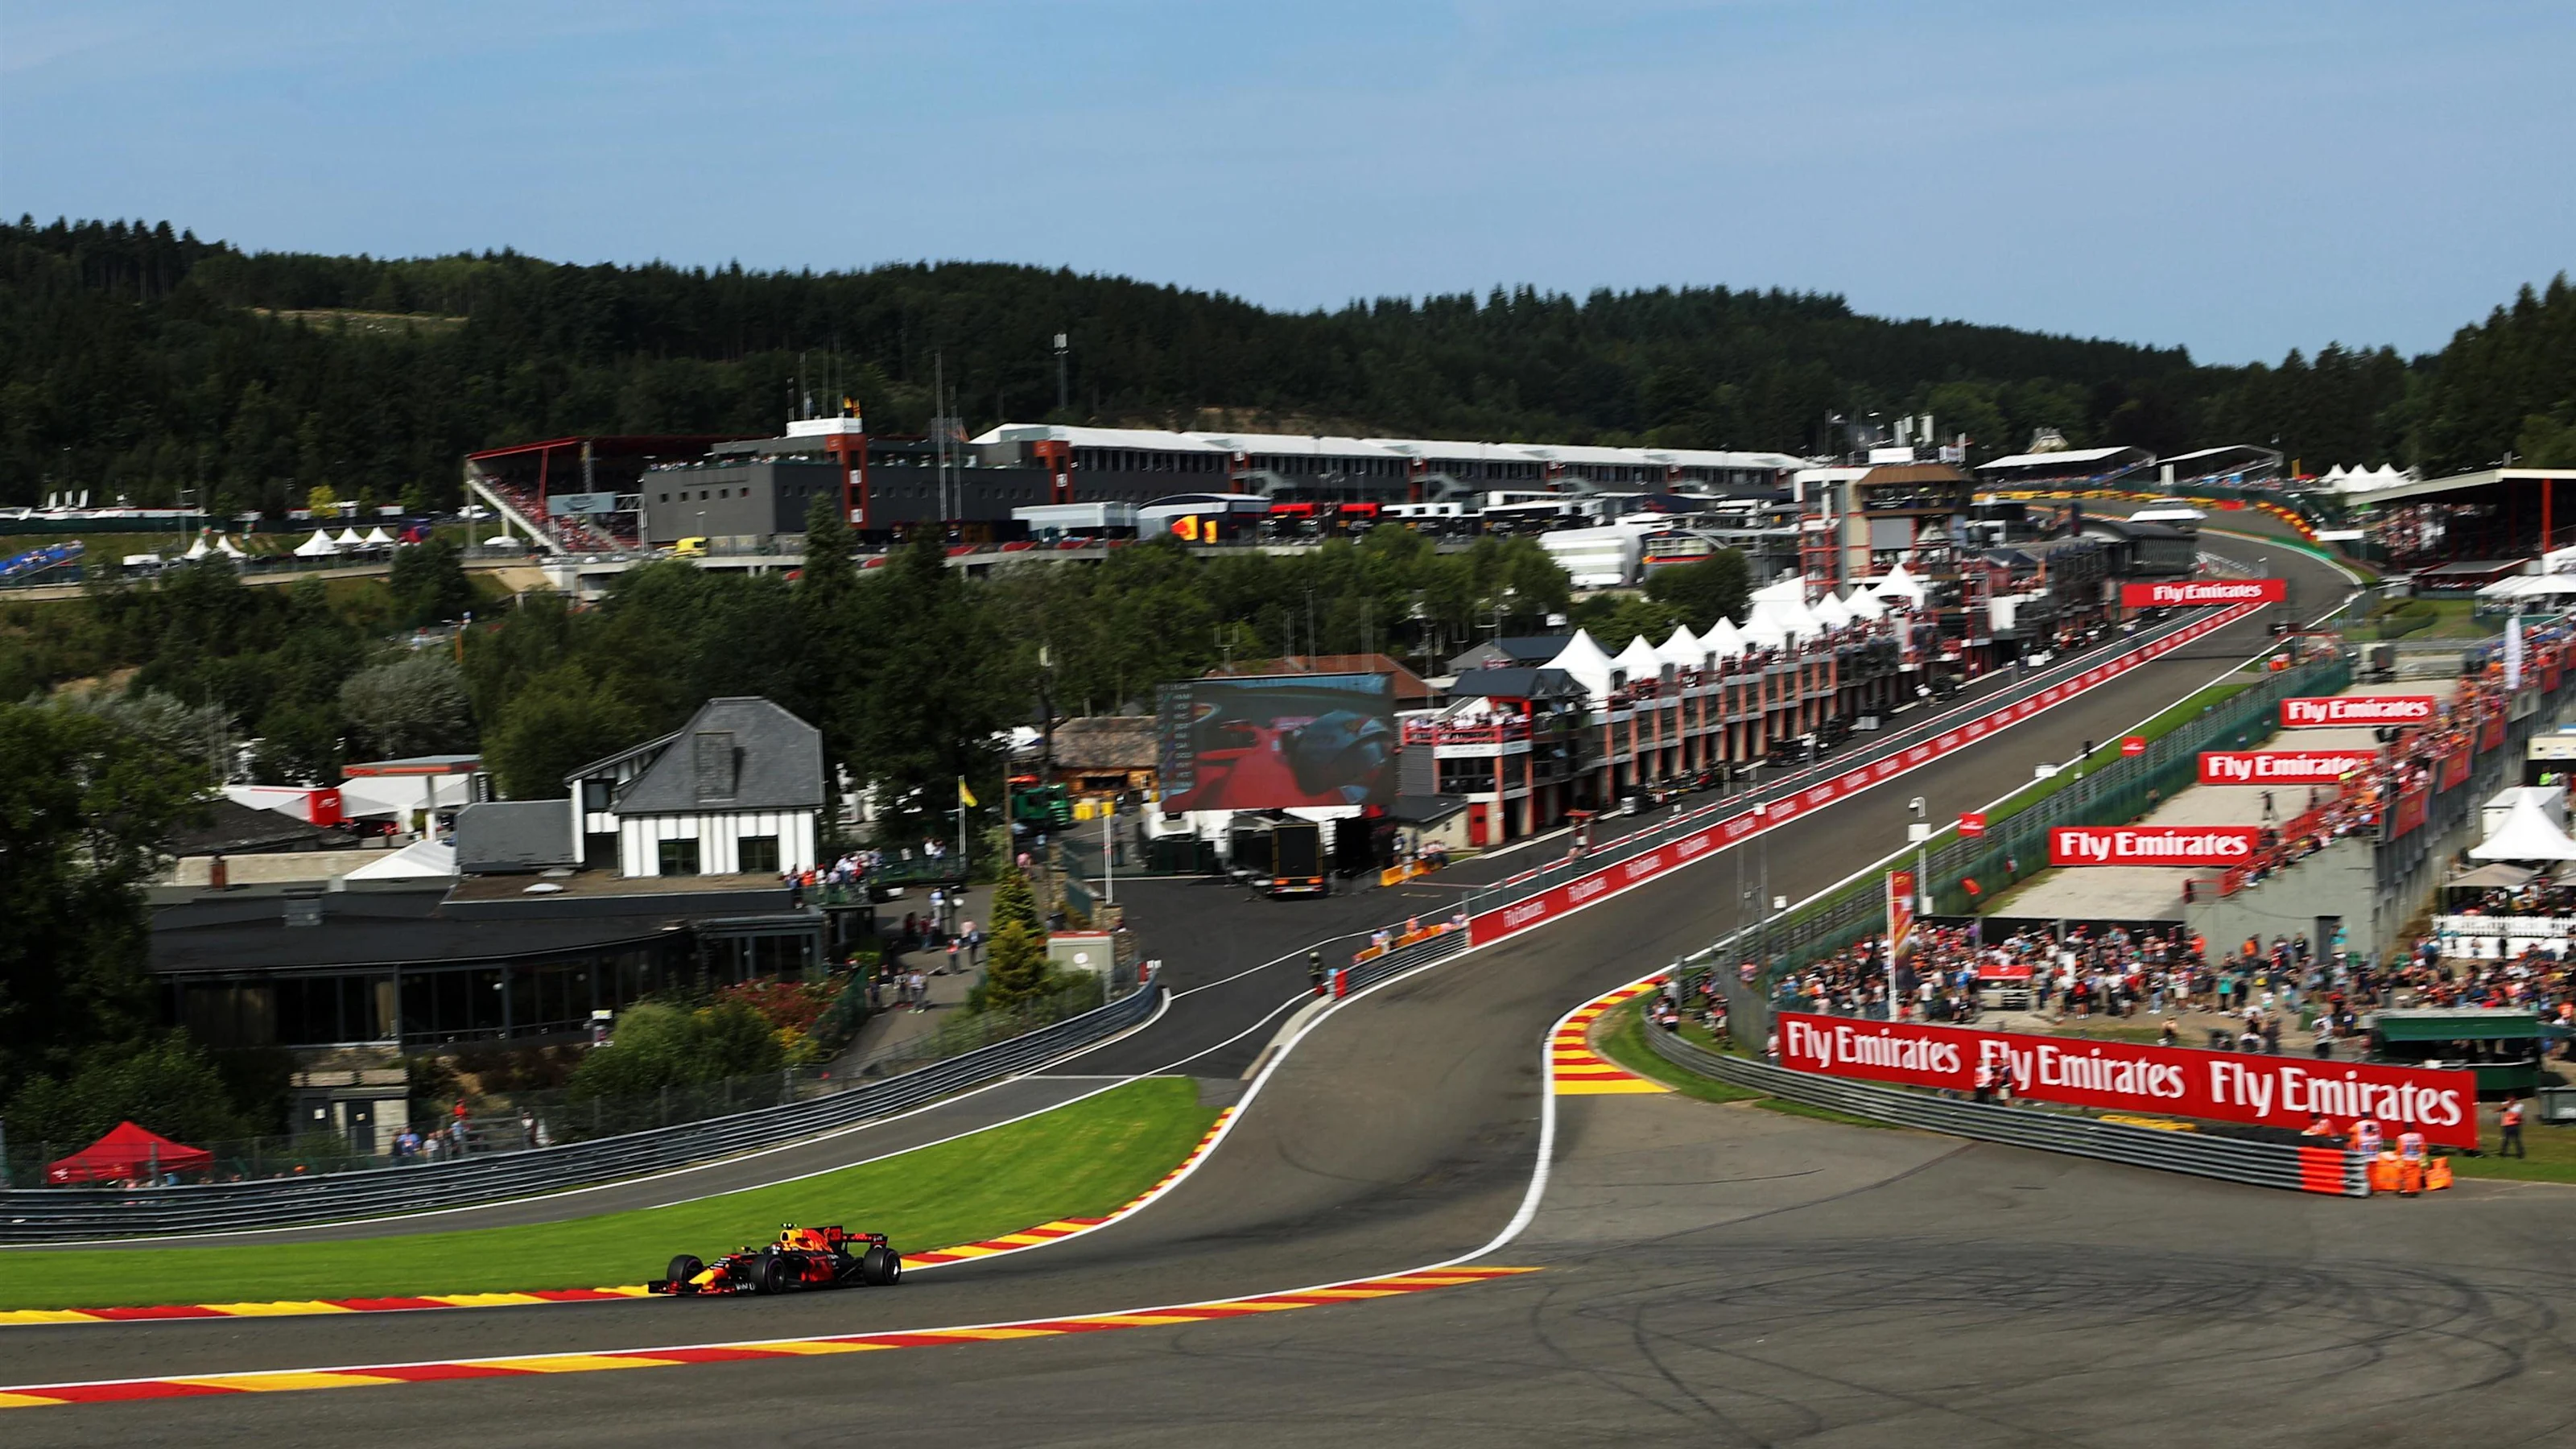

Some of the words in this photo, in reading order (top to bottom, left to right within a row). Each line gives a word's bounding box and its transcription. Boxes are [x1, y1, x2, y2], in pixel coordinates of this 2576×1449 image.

[2153, 585, 2185, 602] Fly
[2186, 583, 2263, 600] Emirates
[2287, 701, 2327, 723] Fly
[2329, 699, 2429, 719] Emirates
[2207, 755, 2253, 781] Fly
[2255, 753, 2366, 777] Emirate
[2059, 831, 2112, 861] Fly
[2114, 830, 2248, 856] Emirates
[1786, 1021, 1832, 1068] Fly
[1834, 1026, 1962, 1074] Emirates
[2037, 1045, 2186, 1098] Emirates
[2209, 1060, 2274, 1117] Fly
[2278, 1067, 2462, 1126] Emirates
